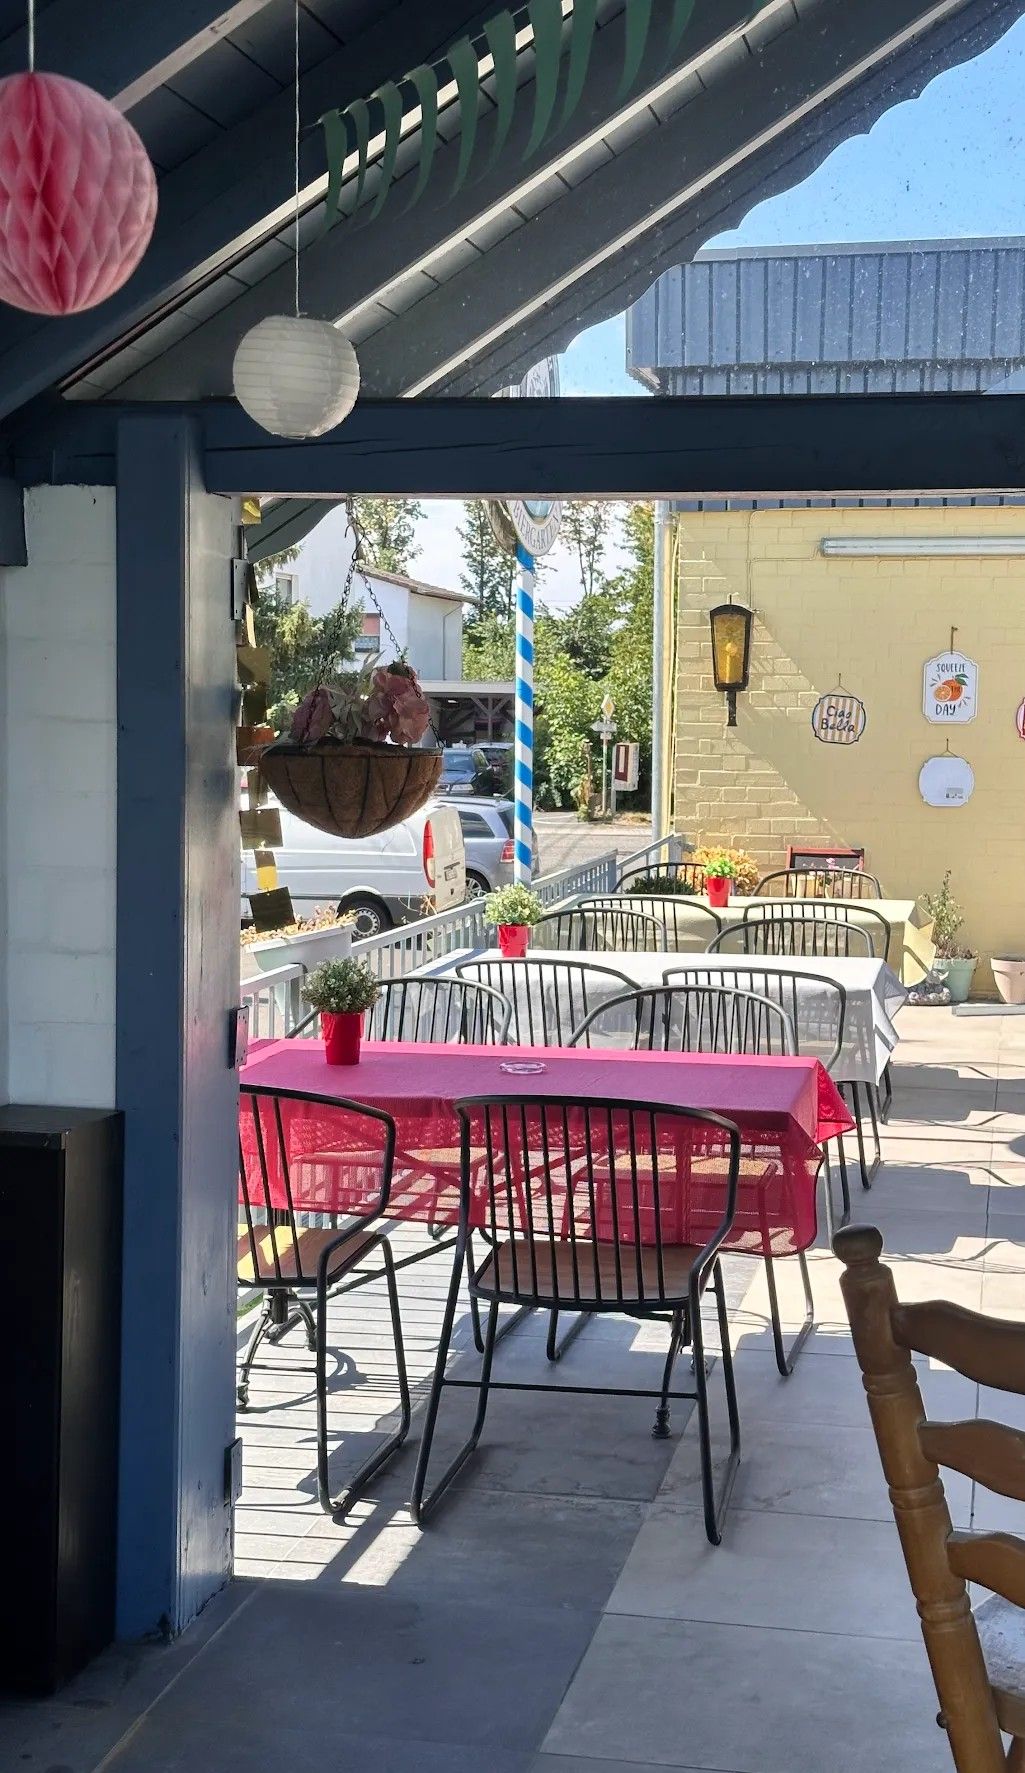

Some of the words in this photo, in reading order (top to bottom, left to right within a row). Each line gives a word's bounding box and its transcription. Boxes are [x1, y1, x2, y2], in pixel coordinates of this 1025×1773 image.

[936, 663, 966, 673] SQUEEZE
[827, 705, 852, 719] Ciao
[935, 704, 956, 716] DAY
[821, 718, 855, 733] Bella
